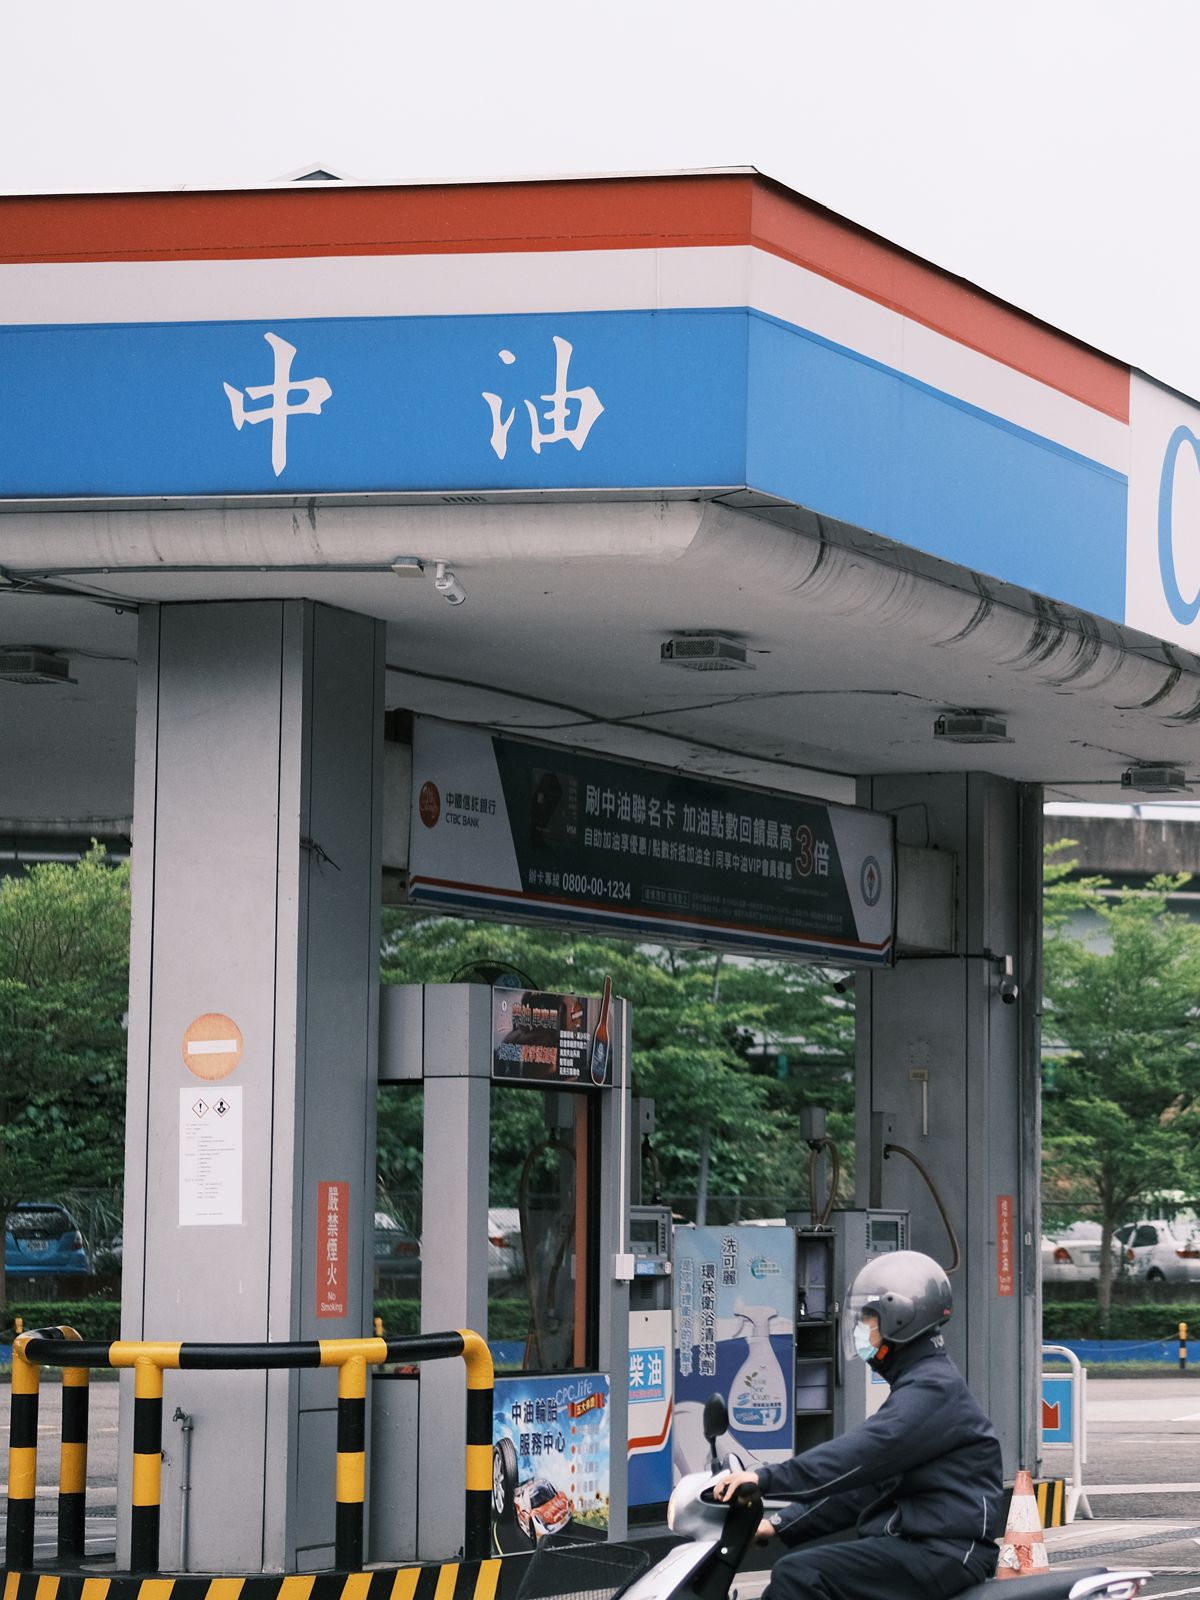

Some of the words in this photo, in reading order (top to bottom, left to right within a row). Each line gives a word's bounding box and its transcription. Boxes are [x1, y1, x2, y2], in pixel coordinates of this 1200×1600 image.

[223, 332, 605, 477] 中油
[446, 790, 497, 817] 中國信託銀行
[585, 784, 677, 829] 刷中油聯名卡
[445, 812, 462, 826] CTBC
[462, 815, 480, 829] BANK
[562, 872, 631, 900] 0800-00-1234
[326, 1186, 339, 1286] 嚴禁煙火
[721, 1236, 738, 1286] 洗可麗
[320, 1302, 343, 1313] Smoking
[327, 1291, 336, 1301] No
[699, 1263, 716, 1376] 環保衛浴清潔劑
[629, 1354, 662, 1387] 柴油
[511, 1397, 558, 1425] 中油輪胎
[519, 1431, 566, 1456] 服務中心
